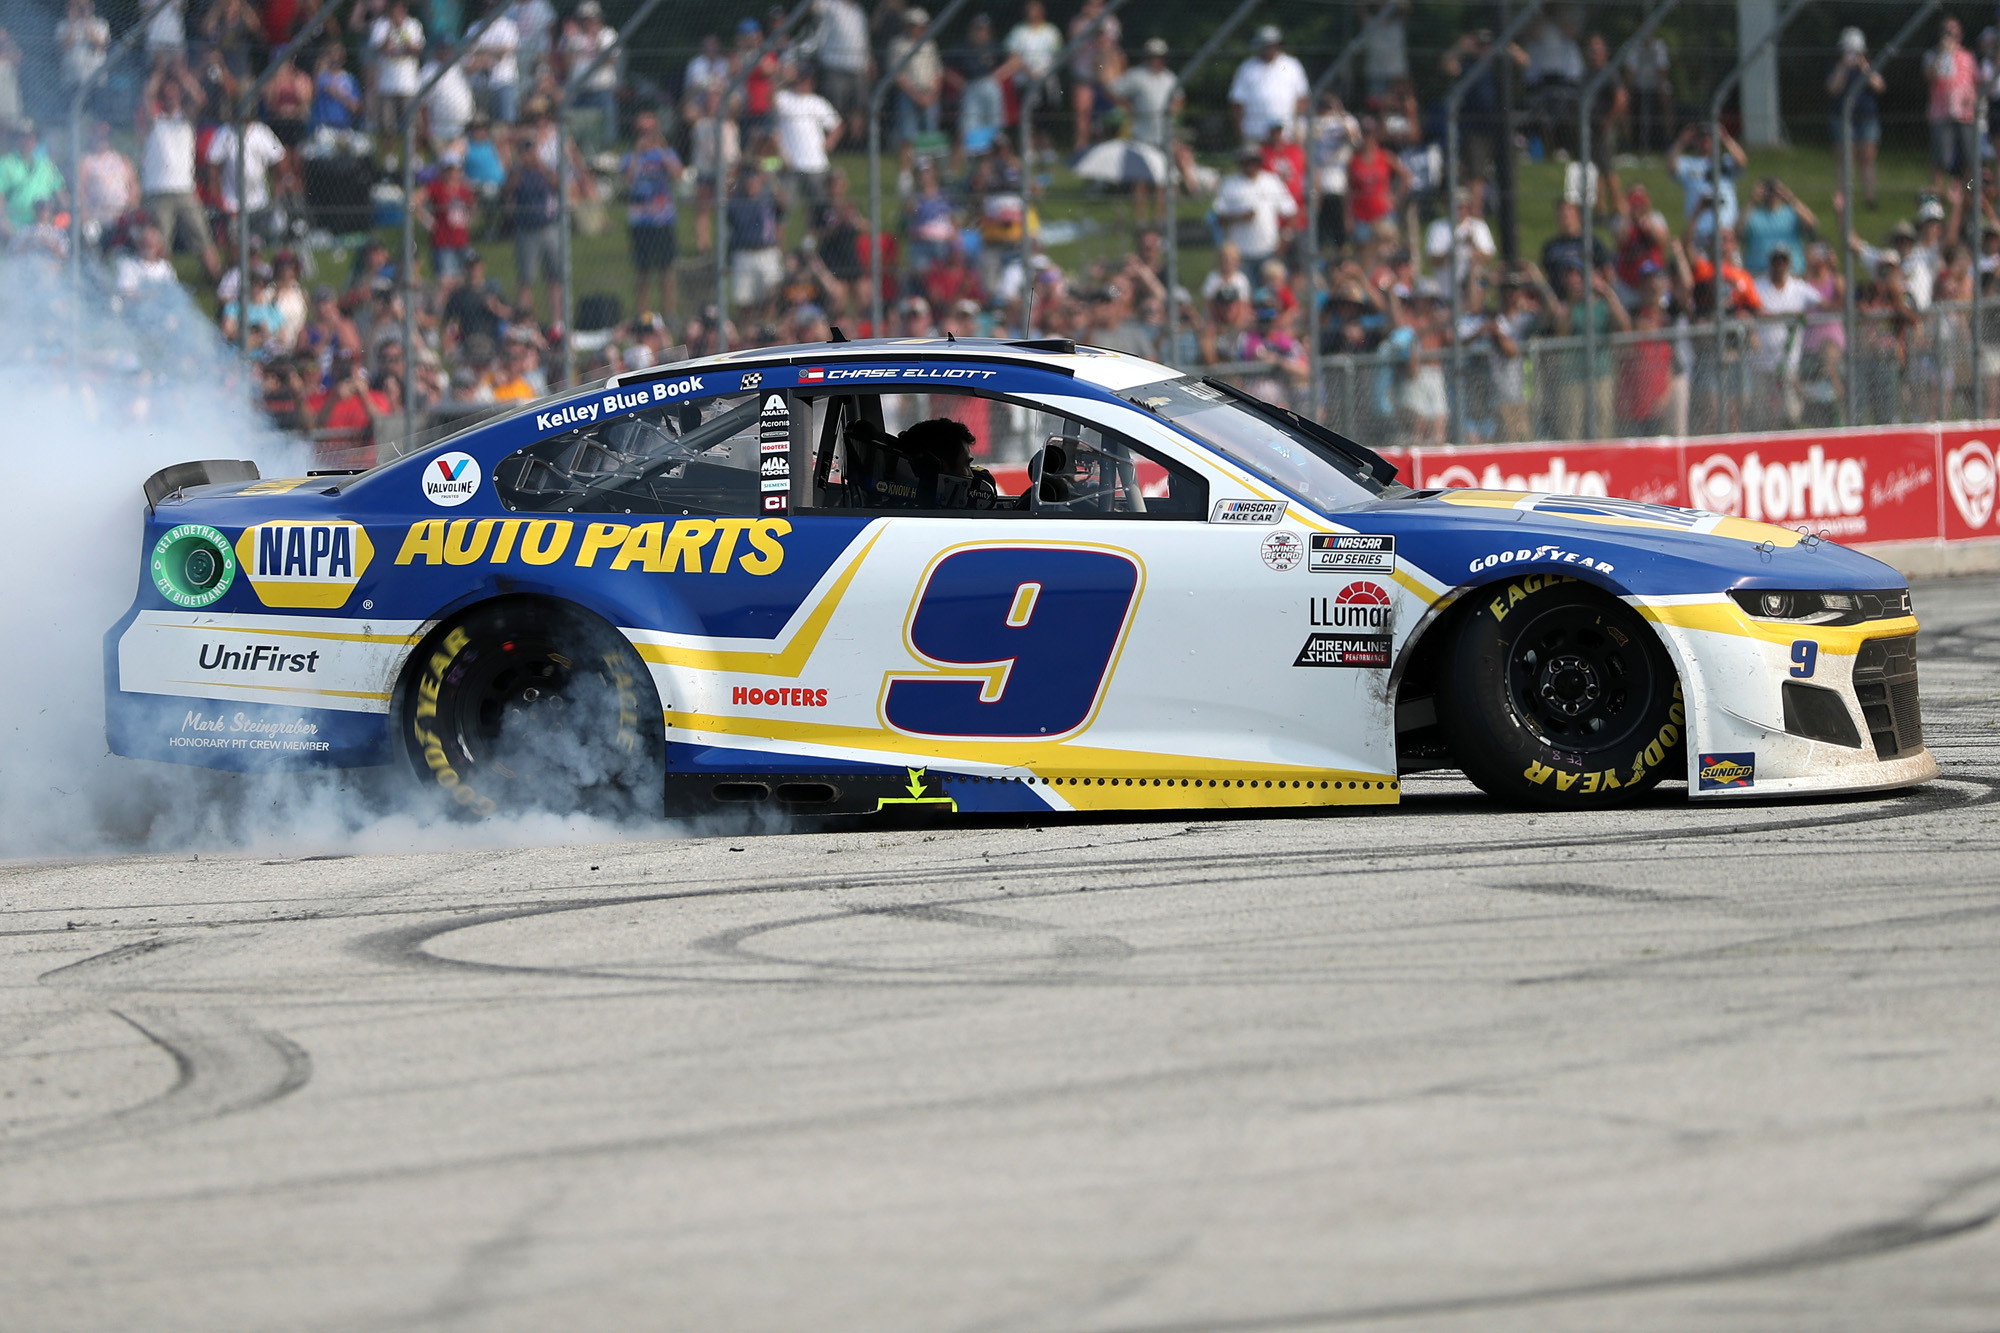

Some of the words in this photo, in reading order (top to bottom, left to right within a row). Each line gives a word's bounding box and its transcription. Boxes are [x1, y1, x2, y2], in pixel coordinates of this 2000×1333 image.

[827, 368, 900, 379] CHASE
[902, 368, 997, 380] ELLIOTT
[536, 402, 600, 431] Kelley
[602, 390, 650, 414] Blue
[652, 376, 704, 401] Book
[761, 409, 790, 417] AXALTA
[761, 420, 790, 428] Acronis
[762, 444, 788, 452] HOOTERS
[761, 456, 789, 470] MAC
[427, 481, 473, 495] VALVOLINE
[1742, 444, 1865, 521] torke
[888, 483, 910, 497] KNOW
[1236, 502, 1277, 513] NASCAR
[1221, 513, 1248, 521] RACE
[1251, 513, 1272, 522] CAR
[157, 535, 173, 554] GET
[172, 525, 230, 556] BIOETHANOL
[394, 518, 574, 566] AUTO
[575, 518, 793, 576] PARTS
[1337, 537, 1383, 550] NASCAR
[259, 526, 352, 578] NAPA
[1265, 551, 1300, 559] RECORD
[1321, 553, 1344, 564] CUP
[1344, 553, 1383, 565] SERIES
[1469, 545, 1615, 575] GOODYEAR
[158, 577, 174, 596] GET
[173, 577, 231, 606] BIOETHANOL
[1310, 597, 1392, 628] LLumar
[879, 542, 1144, 741] 9
[1308, 637, 1388, 652] ADRENALINE
[199, 643, 320, 673] UniFirst
[1301, 651, 1343, 662] SHOC
[1345, 653, 1385, 662] PERFORMANCE
[1789, 639, 1819, 679] 9
[732, 686, 828, 707] HOOTERS
[181, 710, 226, 733] Mark
[229, 711, 319, 739] Steingraber
[169, 737, 230, 748] HONORARY
[232, 739, 247, 749] PIT
[249, 739, 281, 750] CREW
[283, 741, 330, 751] MEMBER
[1701, 765, 1753, 778] SUNOCO
